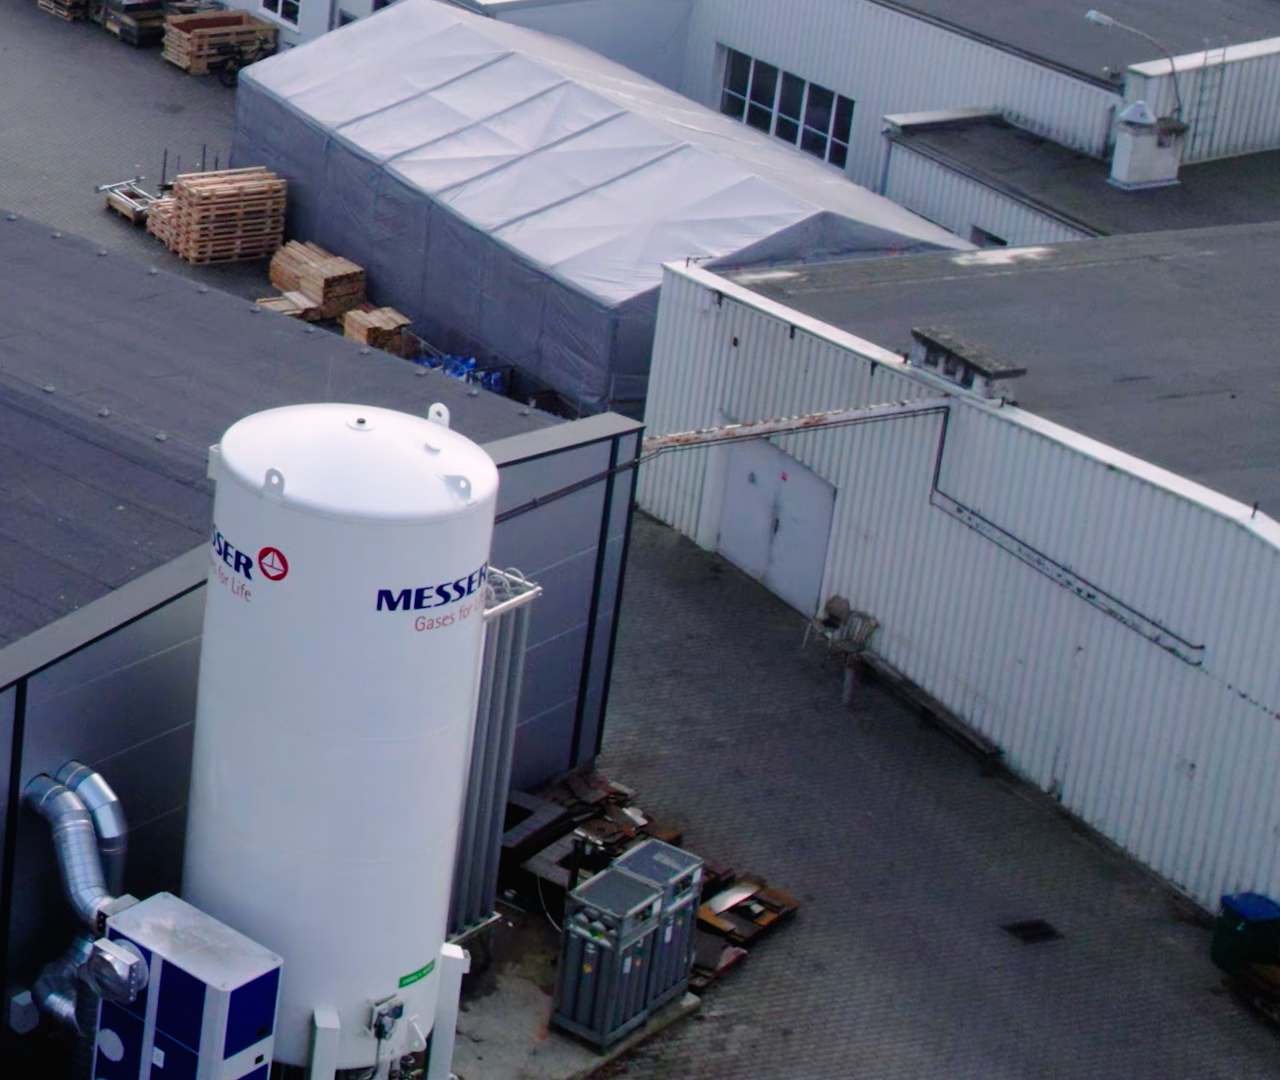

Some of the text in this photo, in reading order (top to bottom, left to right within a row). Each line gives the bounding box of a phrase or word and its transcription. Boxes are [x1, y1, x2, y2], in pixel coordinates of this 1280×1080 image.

[231, 576, 251, 603] Life
[376, 560, 487, 611] MESSER
[414, 613, 455, 632] Gases
